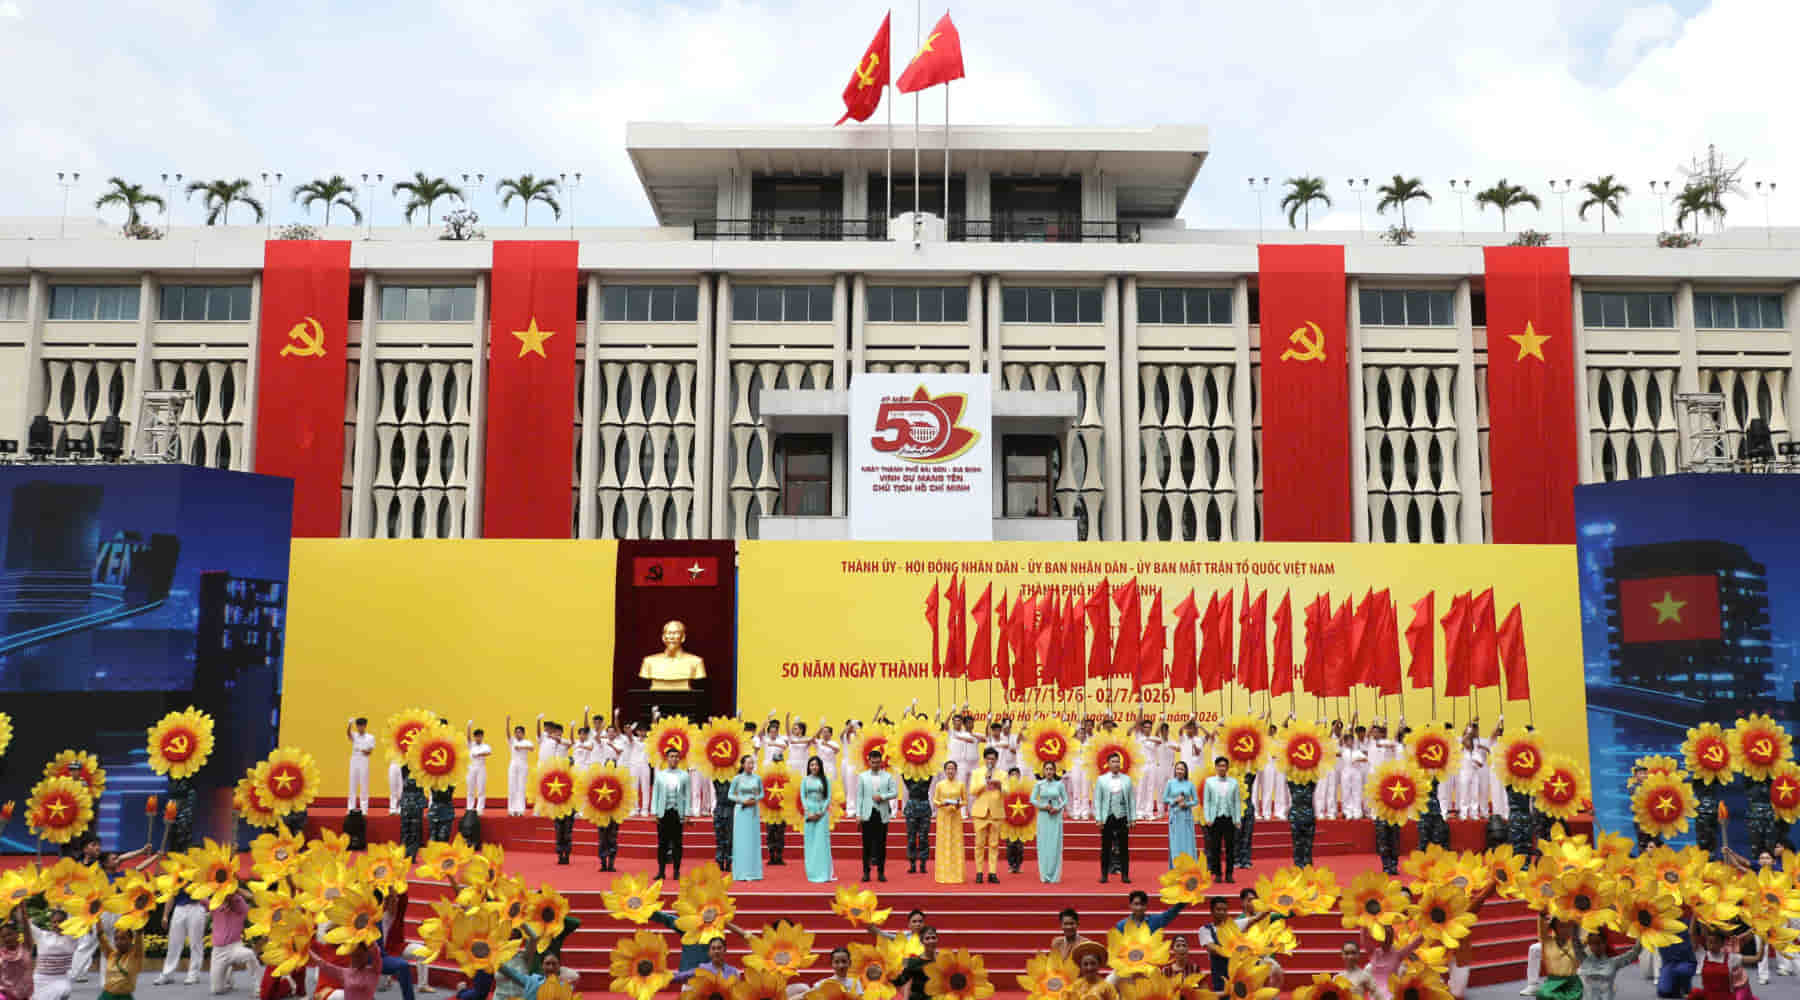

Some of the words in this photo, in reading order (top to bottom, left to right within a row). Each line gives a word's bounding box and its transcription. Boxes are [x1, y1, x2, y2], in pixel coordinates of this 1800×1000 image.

[871, 402, 948, 452] 50
[841, 558, 879, 574] THÀNH
[905, 559, 924, 576] HỘI
[961, 558, 992, 574] NHÂN
[995, 558, 1018, 574] DÂN
[1045, 560, 1068, 574] BAN
[1071, 559, 1101, 574] NHÂN
[1104, 559, 1127, 574] DÂN
[1153, 561, 1177, 574] BAN
[1251, 558, 1281, 576] QUỐC
[1282, 559, 1306, 577] VIỆT
[1309, 561, 1335, 575] NAM
[781, 662, 799, 678] 50
[802, 659, 835, 678] NĂM
[839, 659, 876, 678] NGÀY
[880, 659, 928, 678] THÀNH
[1126, 711, 1156, 723] thng
